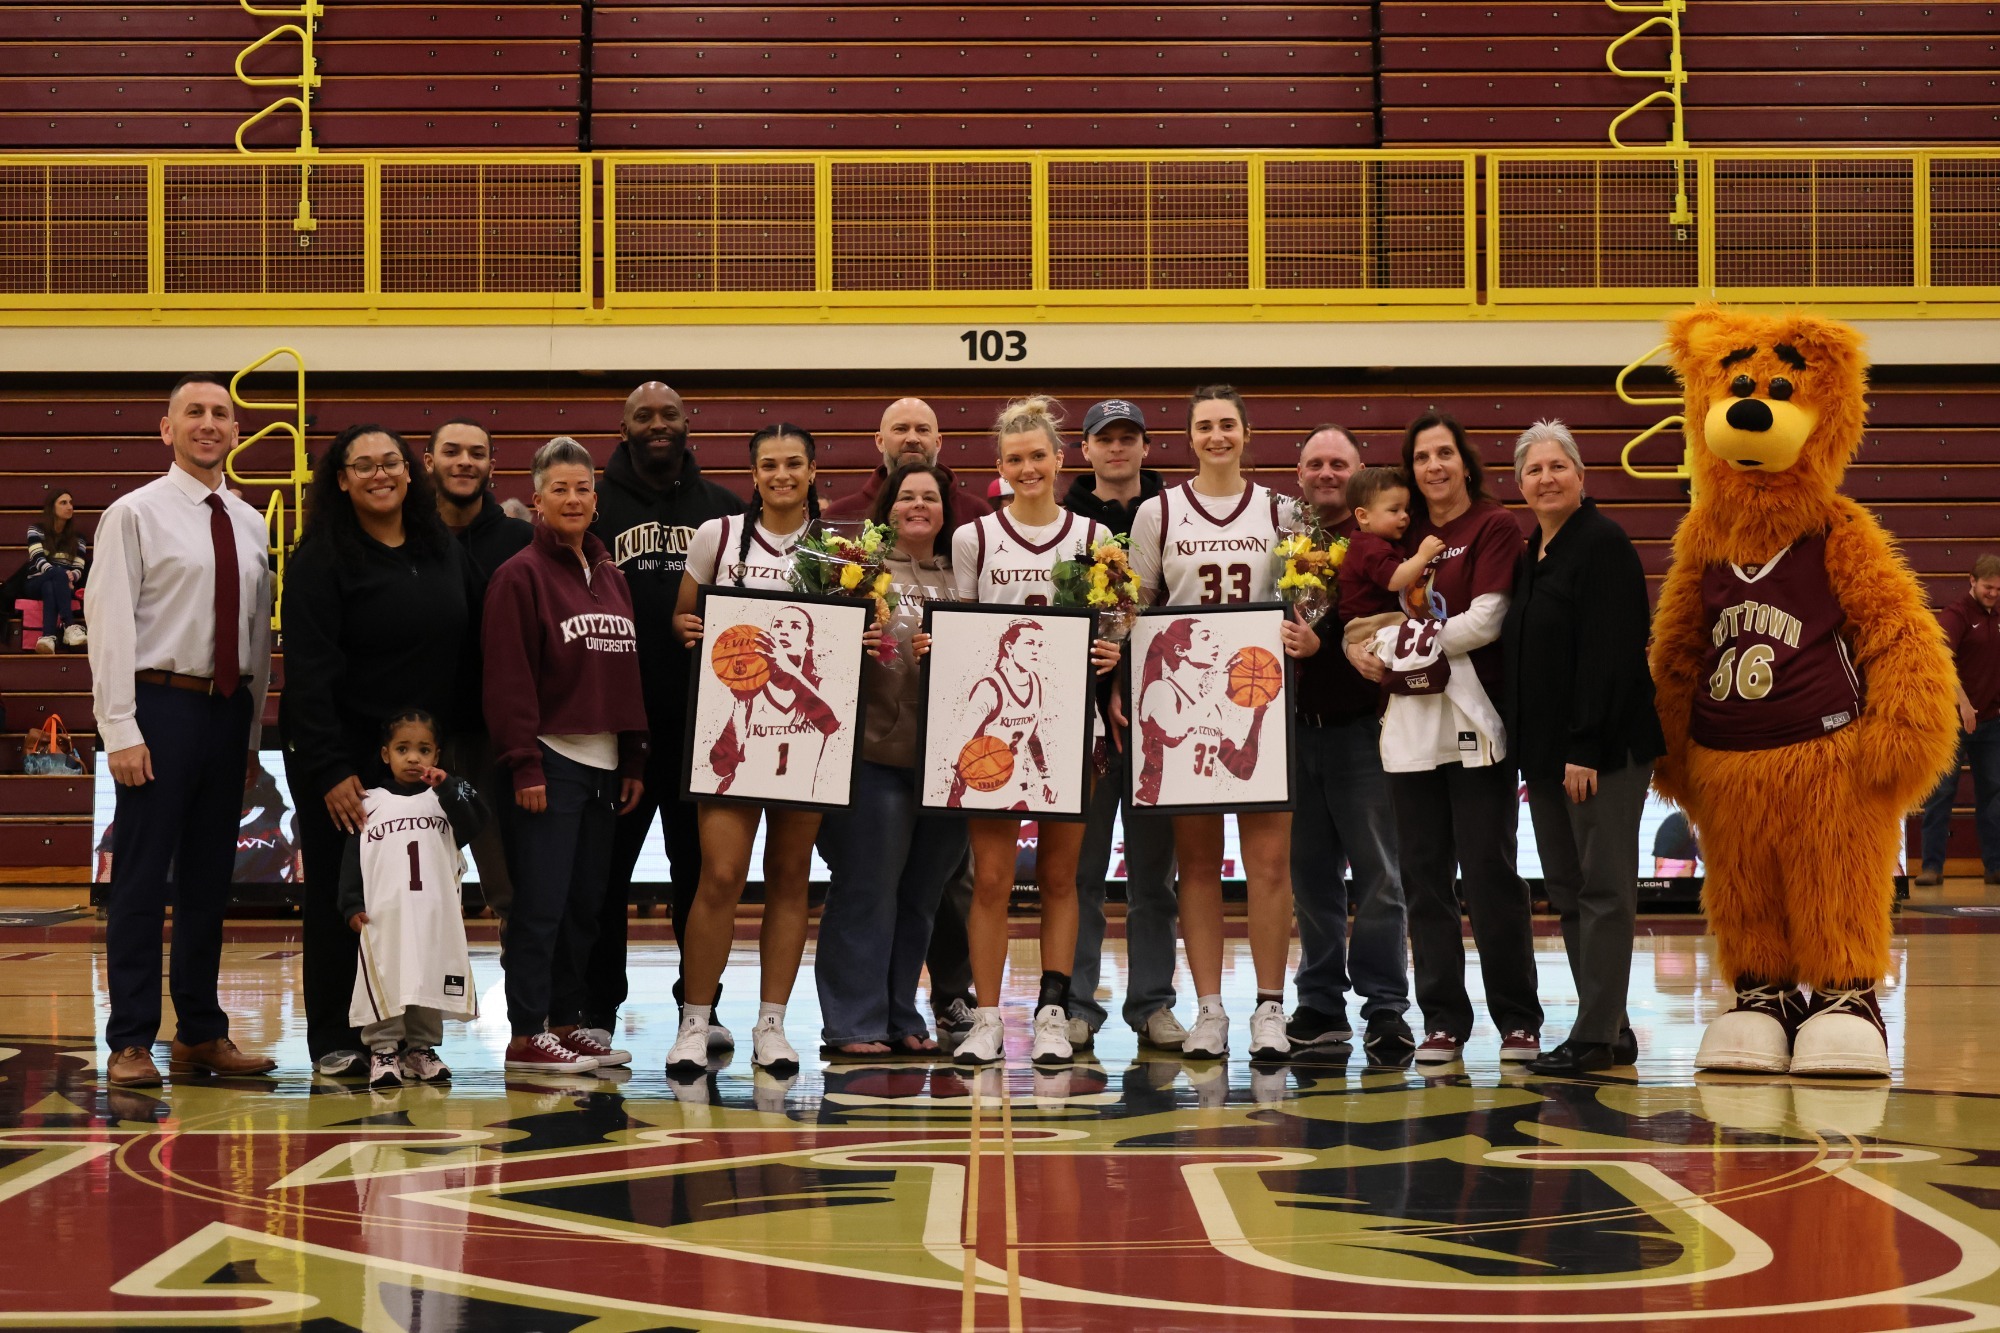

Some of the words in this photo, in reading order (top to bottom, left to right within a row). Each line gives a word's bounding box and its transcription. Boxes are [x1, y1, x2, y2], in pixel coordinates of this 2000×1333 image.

[300, 235, 310, 247] B
[1677, 229, 1687, 240] B
[960, 330, 1027, 362] 103
[1175, 537, 1268, 556] KUTZTOWN
[1199, 563, 1251, 605] 33
[585, 637, 637, 652] UNIVERSITY
[1709, 644, 1775, 702] 66
[775, 742, 790, 776] 1
[406, 840, 423, 891] 1
